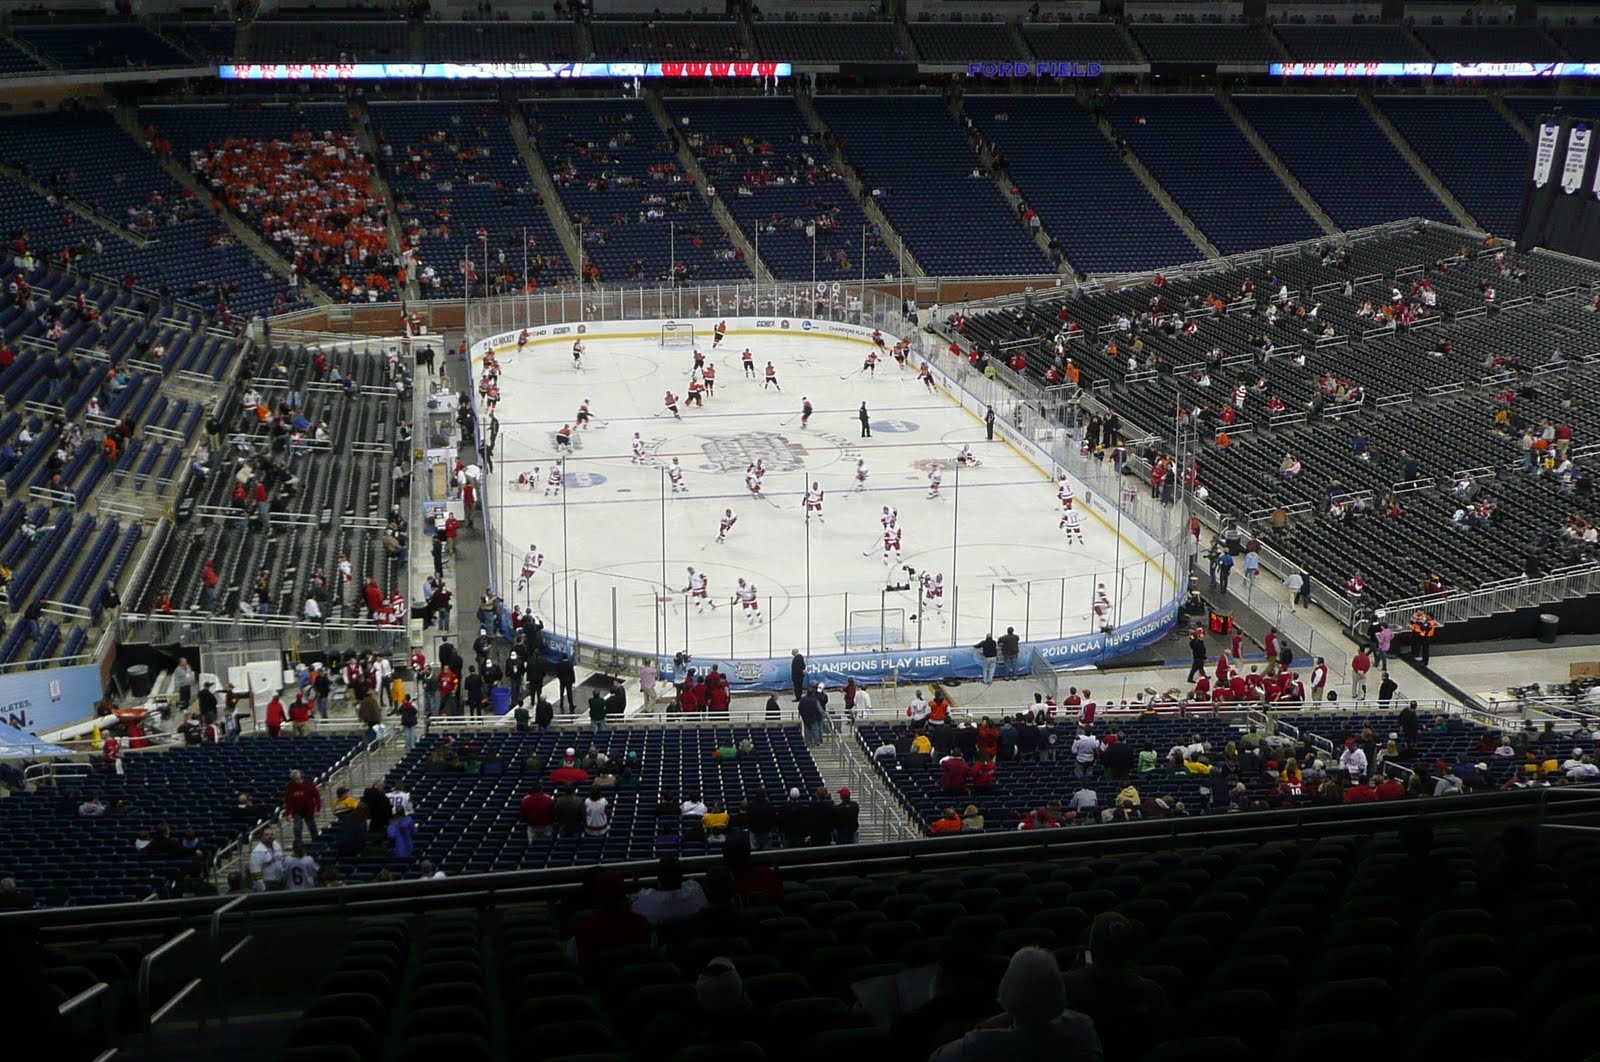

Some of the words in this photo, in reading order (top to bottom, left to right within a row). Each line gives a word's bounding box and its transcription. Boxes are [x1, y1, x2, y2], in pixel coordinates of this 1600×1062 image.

[969, 62, 1029, 77] FORD
[1036, 62, 1103, 77] FIELD
[1042, 645, 1068, 657] 2010
[1070, 640, 1100, 653] NCAA
[1105, 632, 1130, 647] MEN'S
[1131, 620, 1160, 639] FROZEN
[805, 659, 878, 674] CHAMPIONS
[881, 657, 913, 669] PLAY
[915, 655, 950, 667] HERE.
[291, 866, 303, 885] 6
